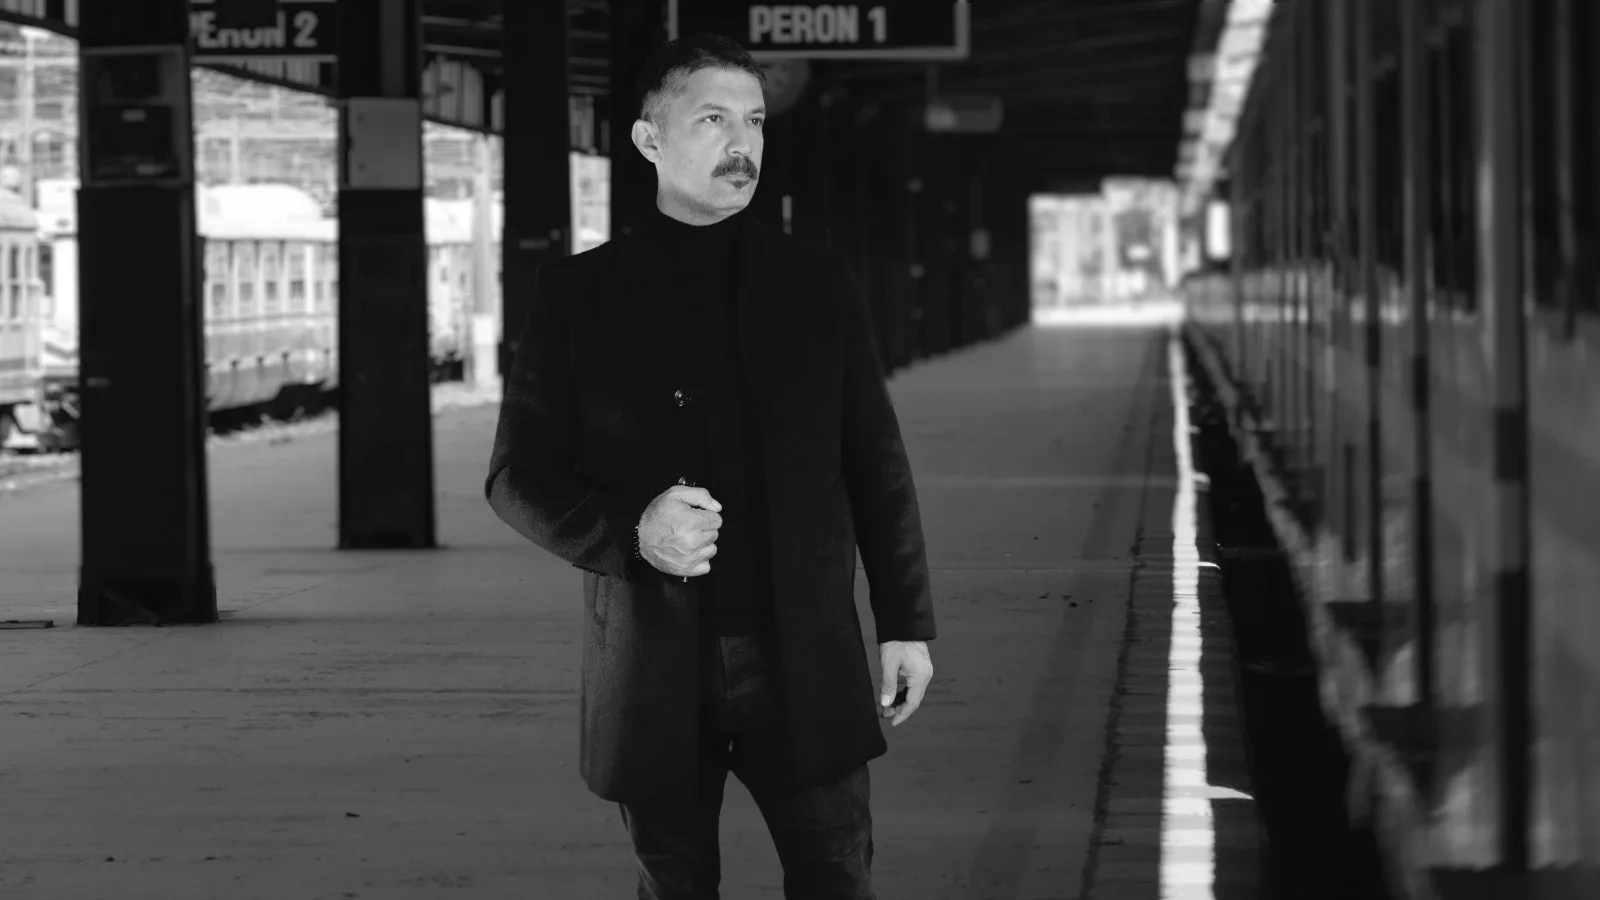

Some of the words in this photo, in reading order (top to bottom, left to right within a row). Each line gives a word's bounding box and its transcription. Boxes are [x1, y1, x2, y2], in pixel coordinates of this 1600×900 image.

[293, 10, 319, 48] 2
[749, 5, 859, 43] PERON
[867, 6, 887, 43] 1
